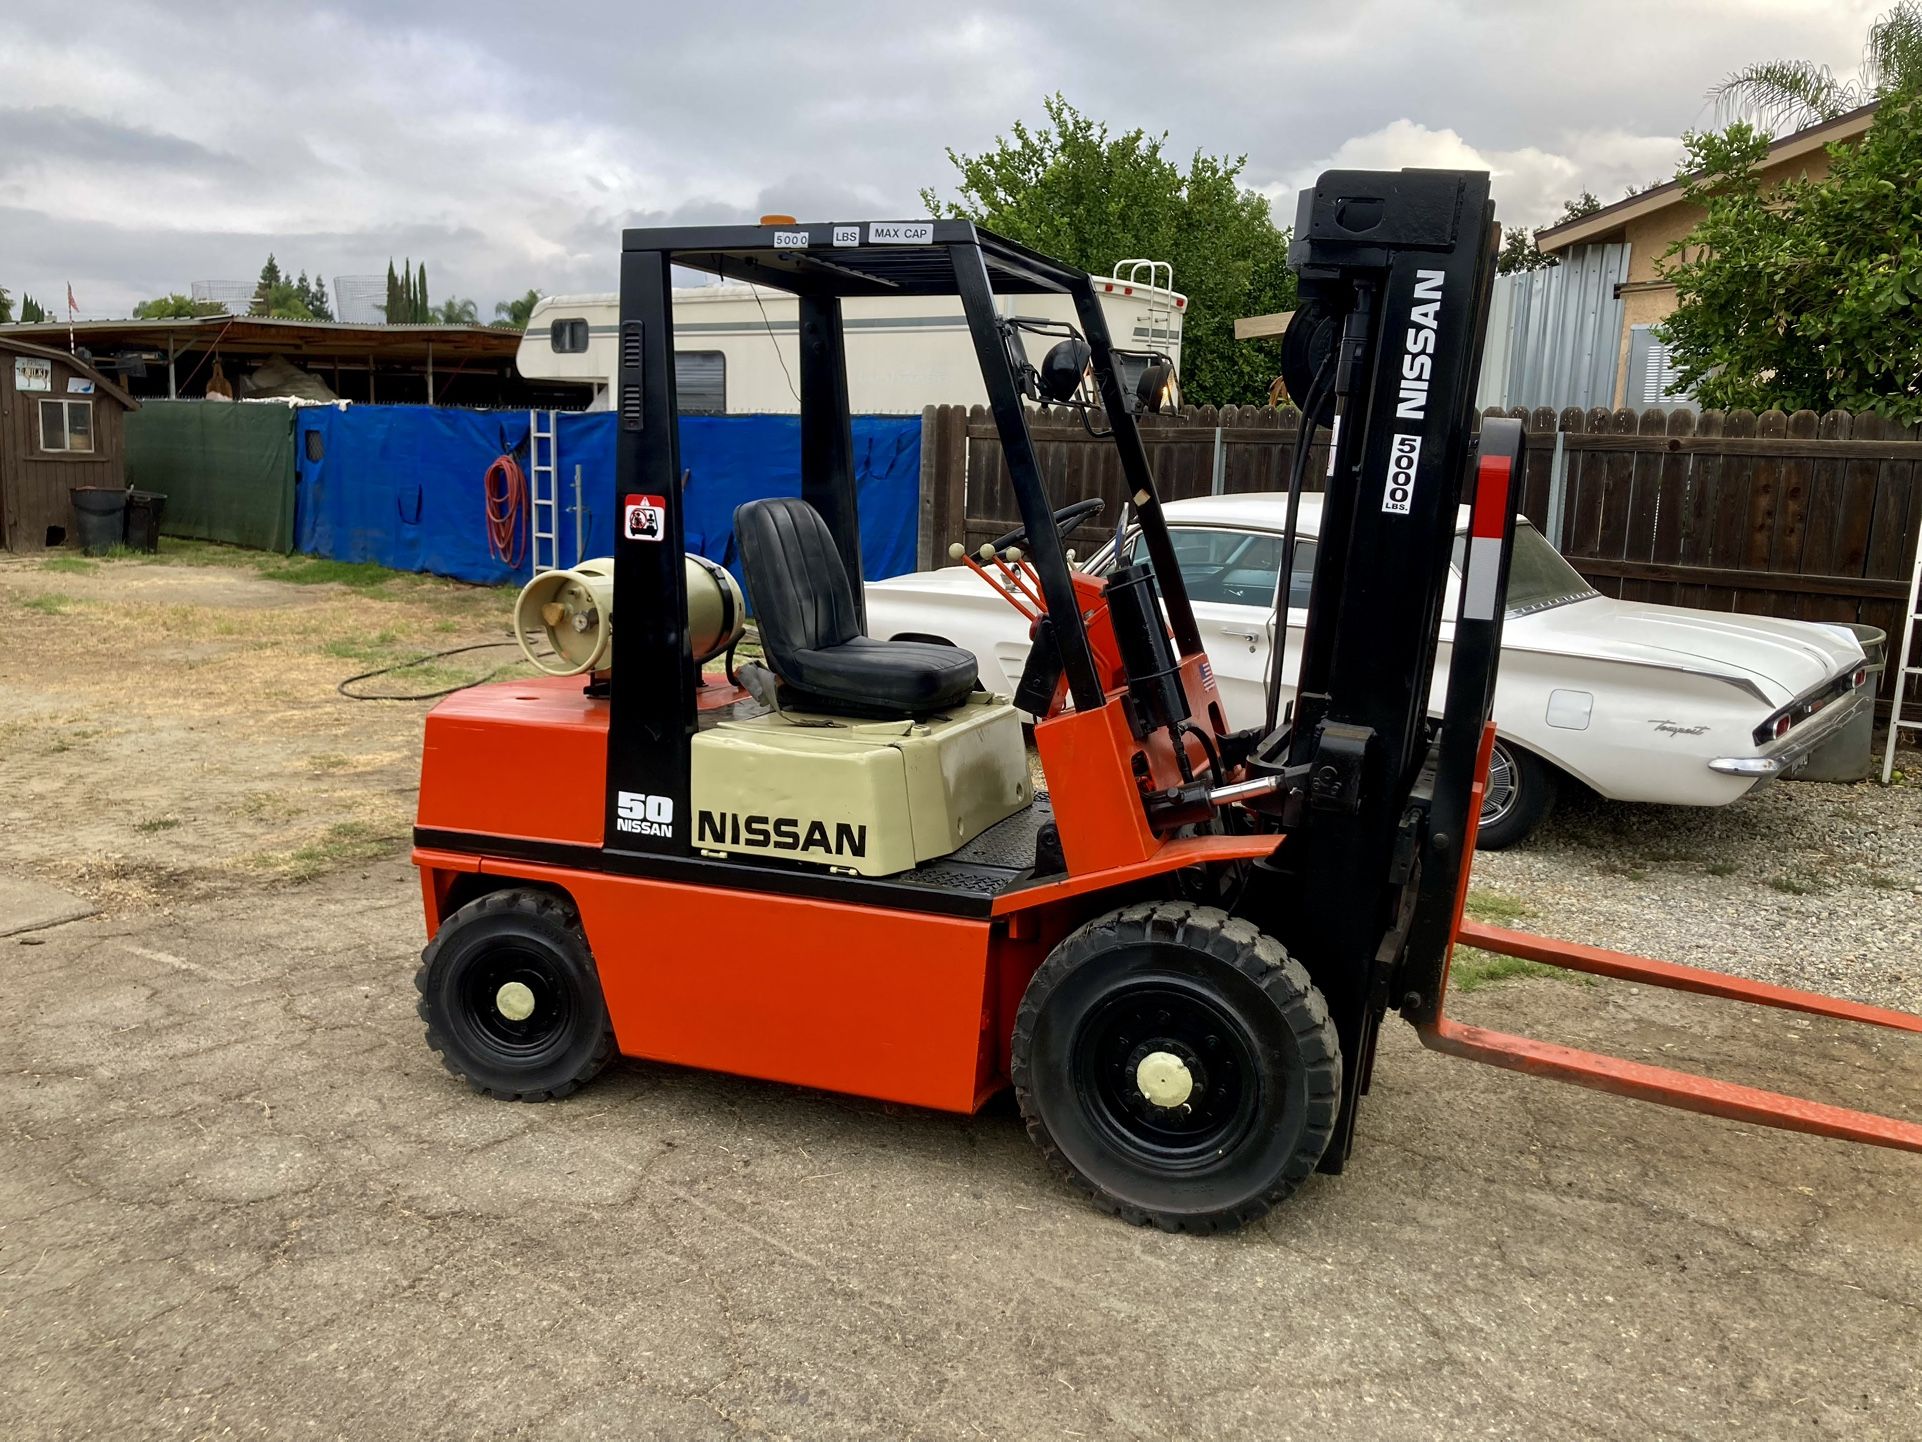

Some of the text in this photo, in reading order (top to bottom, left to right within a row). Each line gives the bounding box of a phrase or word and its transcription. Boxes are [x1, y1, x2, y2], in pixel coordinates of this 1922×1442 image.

[776, 228, 928, 245] 5000 LBS MAX CAP
[1396, 269, 1446, 420] NISSAN
[1389, 437, 1418, 503] 5000
[1385, 502, 1408, 512] LBS.
[617, 790, 674, 824] 50
[616, 818, 673, 838] NISSAN
[698, 809, 867, 858] NISSAN
